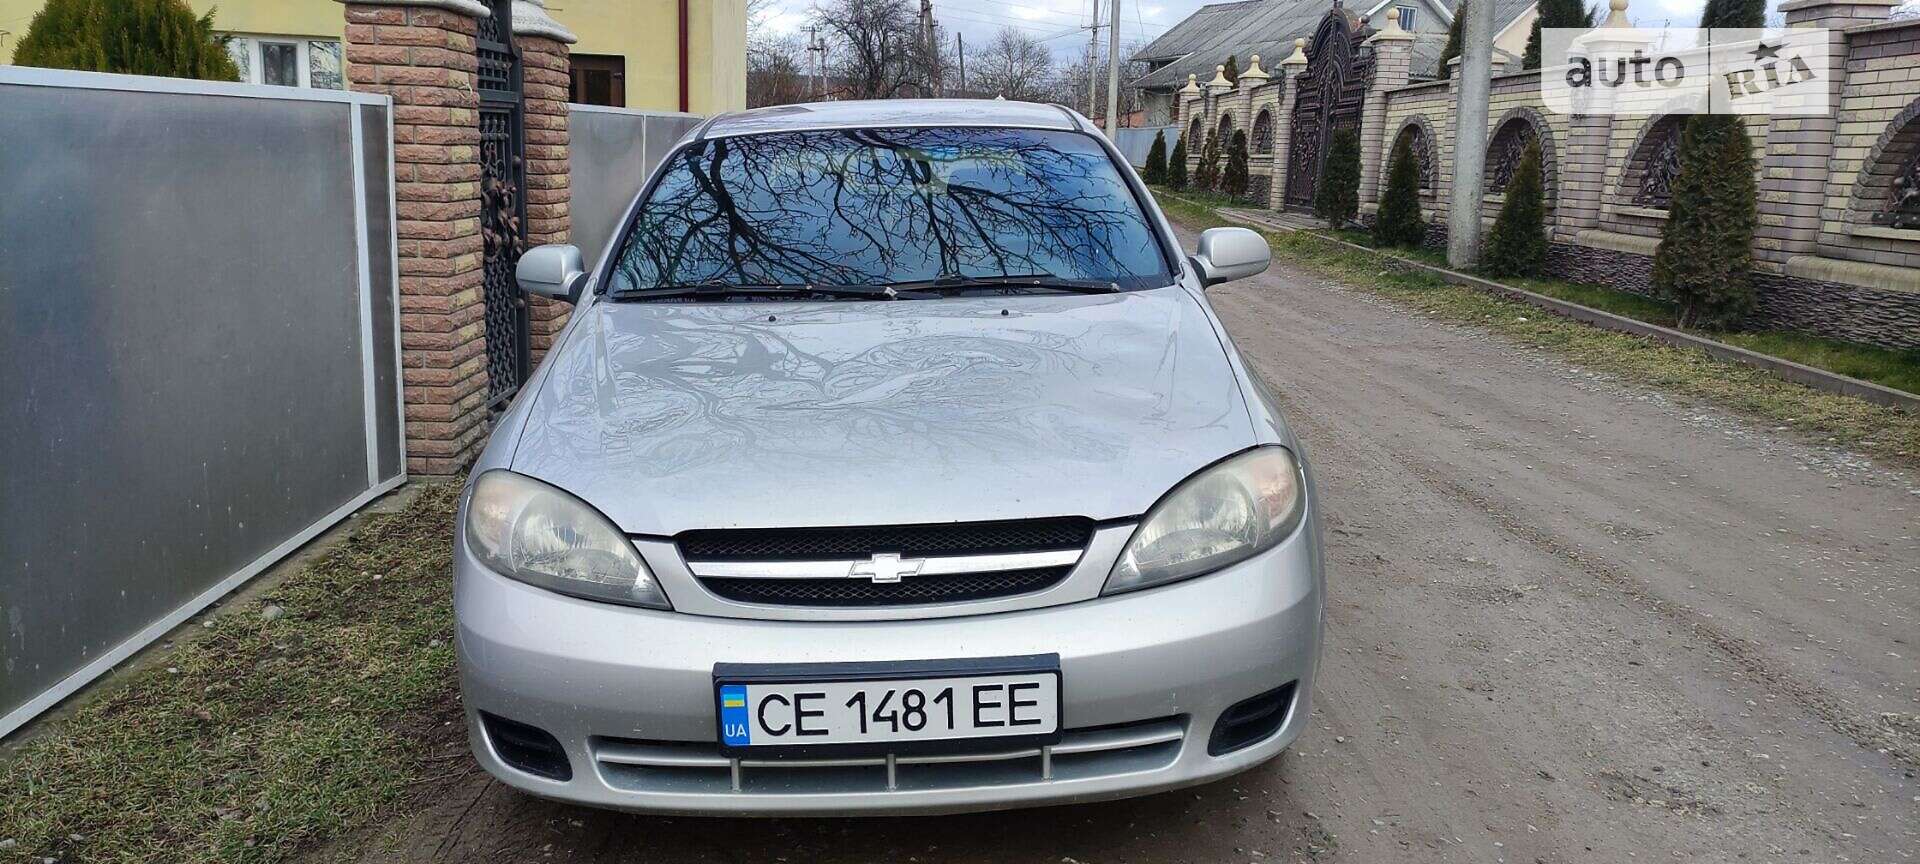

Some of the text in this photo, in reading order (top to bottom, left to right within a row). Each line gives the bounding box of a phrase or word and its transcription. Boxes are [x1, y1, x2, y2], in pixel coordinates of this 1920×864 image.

[757, 682, 1041, 737] CE 1481 EE
[725, 724, 747, 738] UA
